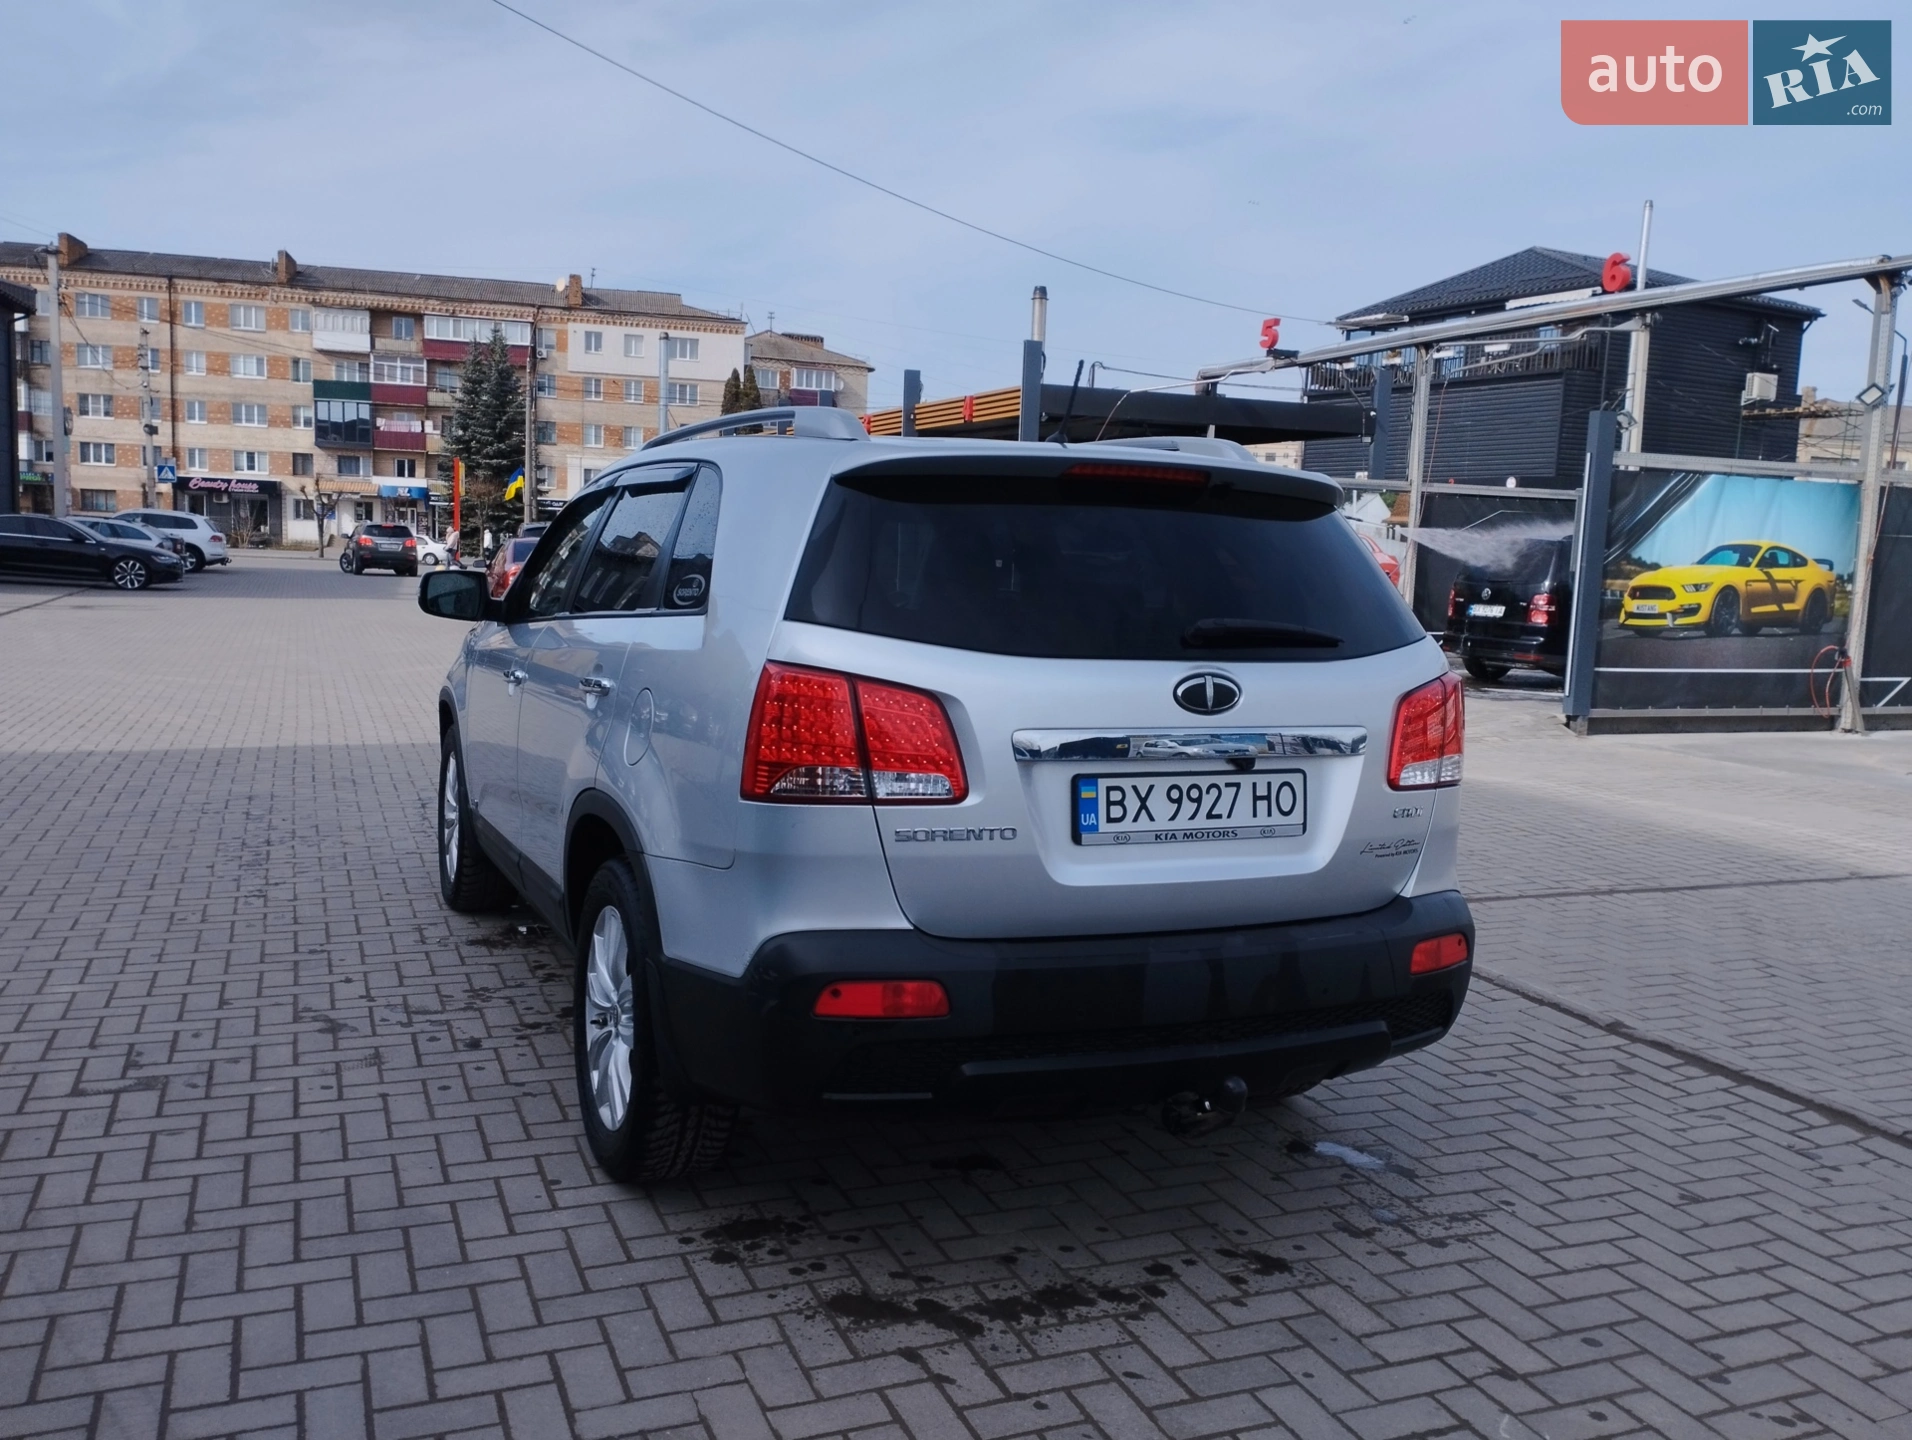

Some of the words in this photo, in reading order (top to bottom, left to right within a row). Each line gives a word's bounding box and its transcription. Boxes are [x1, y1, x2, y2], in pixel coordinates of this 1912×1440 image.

[1602, 252, 1631, 292] 6
[1259, 317, 1281, 349] 5
[962, 395, 974, 422] 4
[188, 477, 228, 491] Beauty
[677, 588, 699, 597] SORENTO
[1105, 784, 1156, 823] BX
[1165, 782, 1242, 821] 9927
[1252, 781, 1297, 818] HO
[1081, 813, 1097, 825] UA
[894, 826, 1018, 842] SORENTO
[1154, 831, 1177, 841] KIA
[1182, 830, 1239, 840] MOTORS
